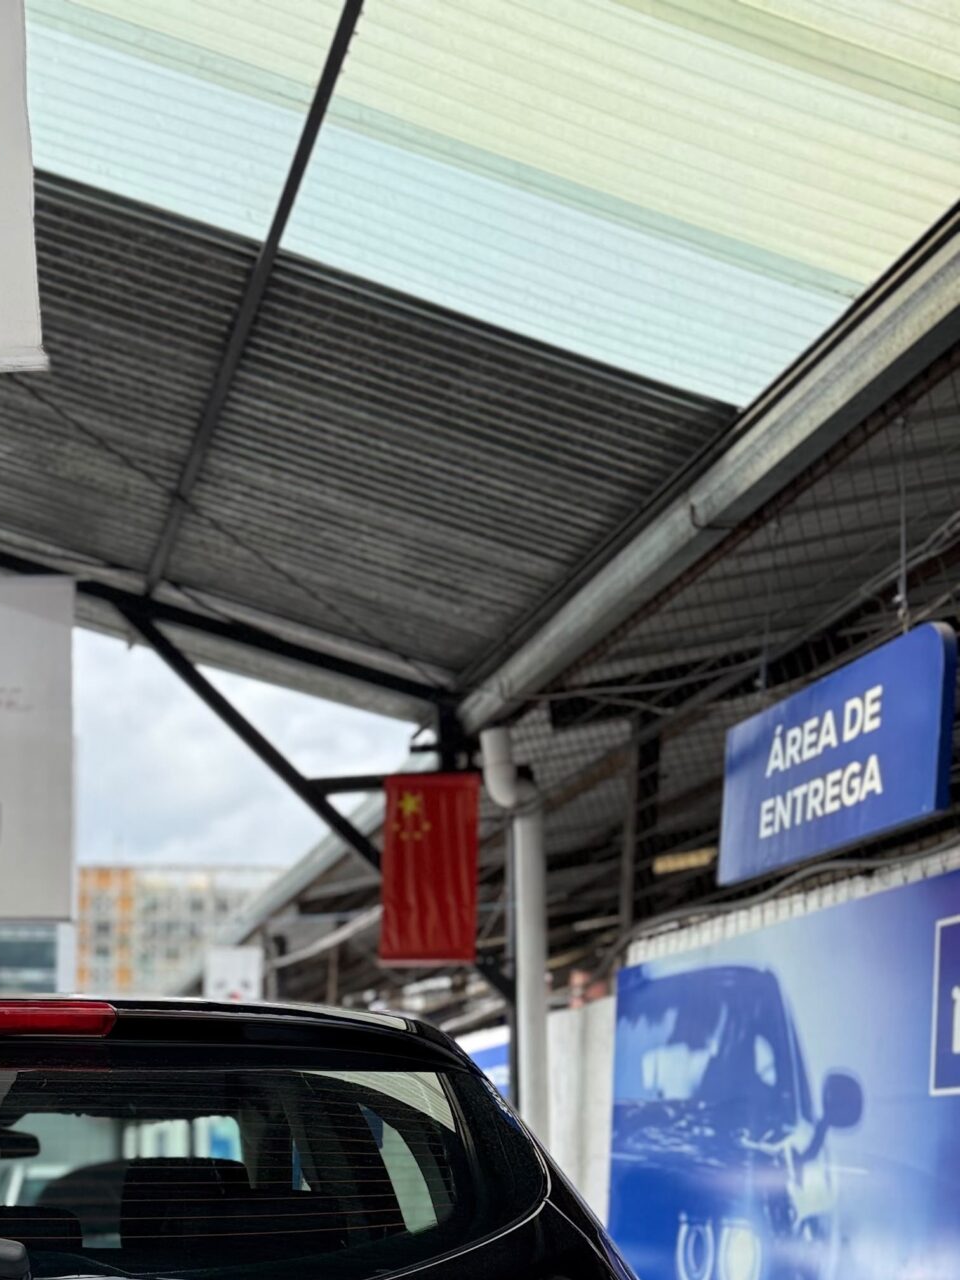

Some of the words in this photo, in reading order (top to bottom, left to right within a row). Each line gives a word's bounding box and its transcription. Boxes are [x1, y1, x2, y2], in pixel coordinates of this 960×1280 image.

[765, 709, 838, 779] ÁREA
[842, 684, 883, 743] DE
[759, 753, 883, 839] ENTREGA
